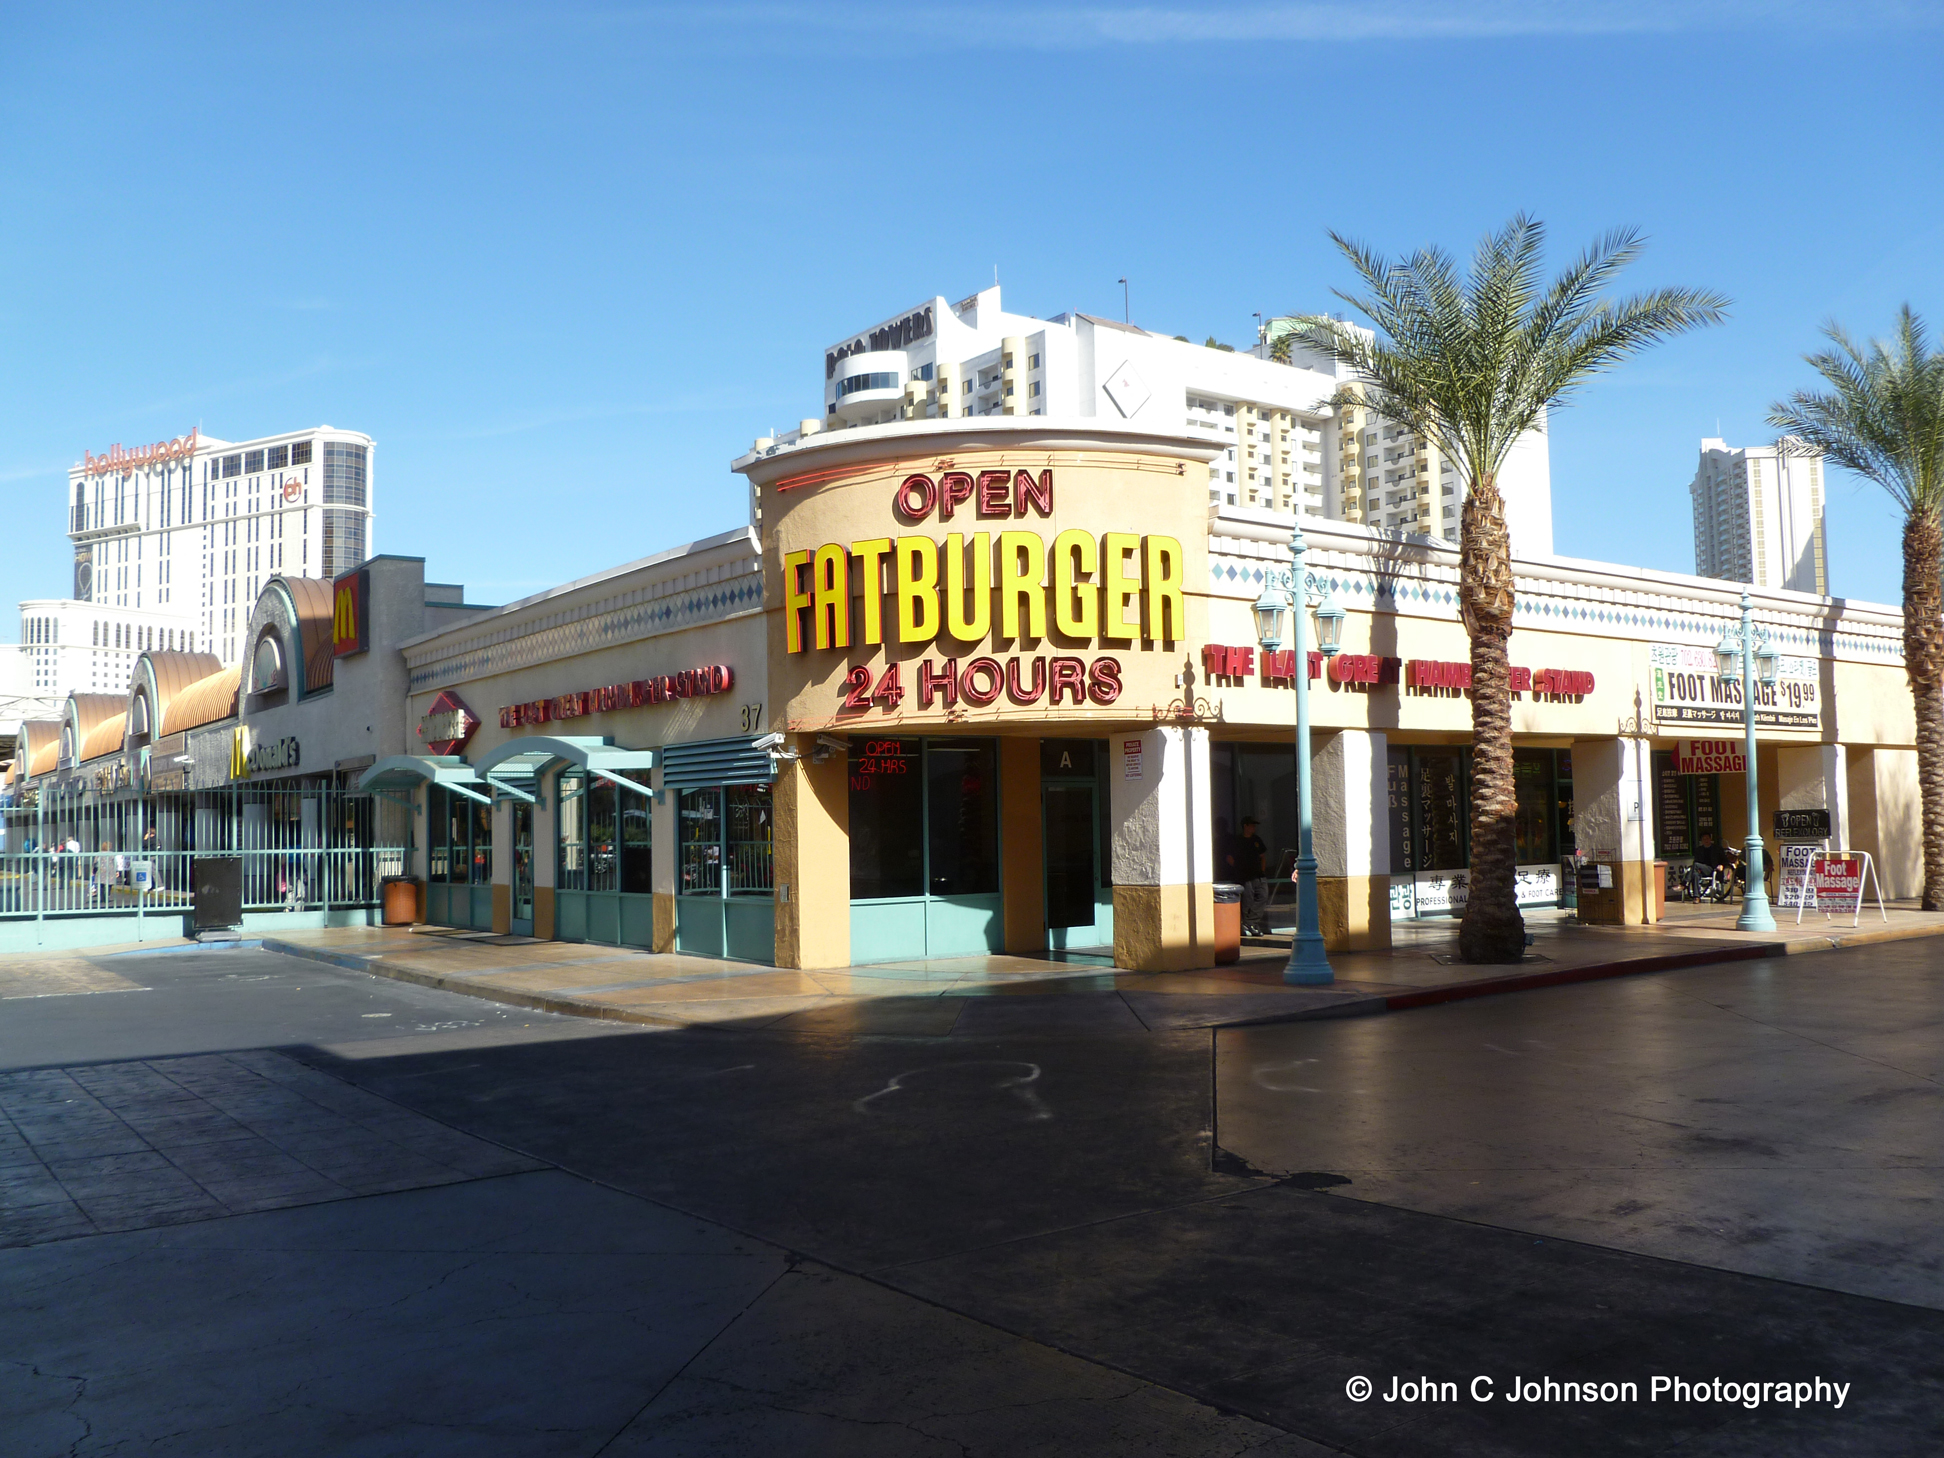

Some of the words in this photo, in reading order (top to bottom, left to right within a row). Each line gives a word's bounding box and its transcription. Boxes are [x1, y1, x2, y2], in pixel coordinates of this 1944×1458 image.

[869, 306, 933, 351] TOWERS
[85, 427, 197, 477] hollywood
[898, 469, 1053, 519] OPEN
[785, 529, 1184, 653] FATBURGER
[1204, 644, 1254, 676] THE
[1330, 654, 1401, 684] GREAT
[1408, 660, 1532, 691] HAMBER
[1535, 668, 1595, 694] STAND
[676, 665, 730, 698] STAND
[846, 661, 905, 708] 24
[922, 656, 1122, 706] HOURS
[1668, 672, 1705, 702] FOOT
[1710, 675, 1777, 706] MASAGE
[740, 703, 762, 732] 37
[866, 741, 900, 756] OPEN
[1690, 740, 1736, 756] FOOT
[859, 757, 877, 773] 24
[881, 759, 907, 774] HRS
[1060, 751, 1071, 768] A
[1398, 764, 1412, 868] Massage
[1790, 815, 1812, 827] OPEN
[1775, 827, 1828, 838] REFLEXOLOGY
[1786, 847, 1816, 857] FOOT
[1782, 857, 1816, 868] MASSAG
[1824, 861, 1847, 875] Foot
[1816, 873, 1859, 891] Massage
[1416, 895, 1468, 907] PROFESSIONAL
[1521, 891, 1526, 899] &
[1529, 888, 1543, 898] FOOT
[1545, 888, 1563, 897] CARE
